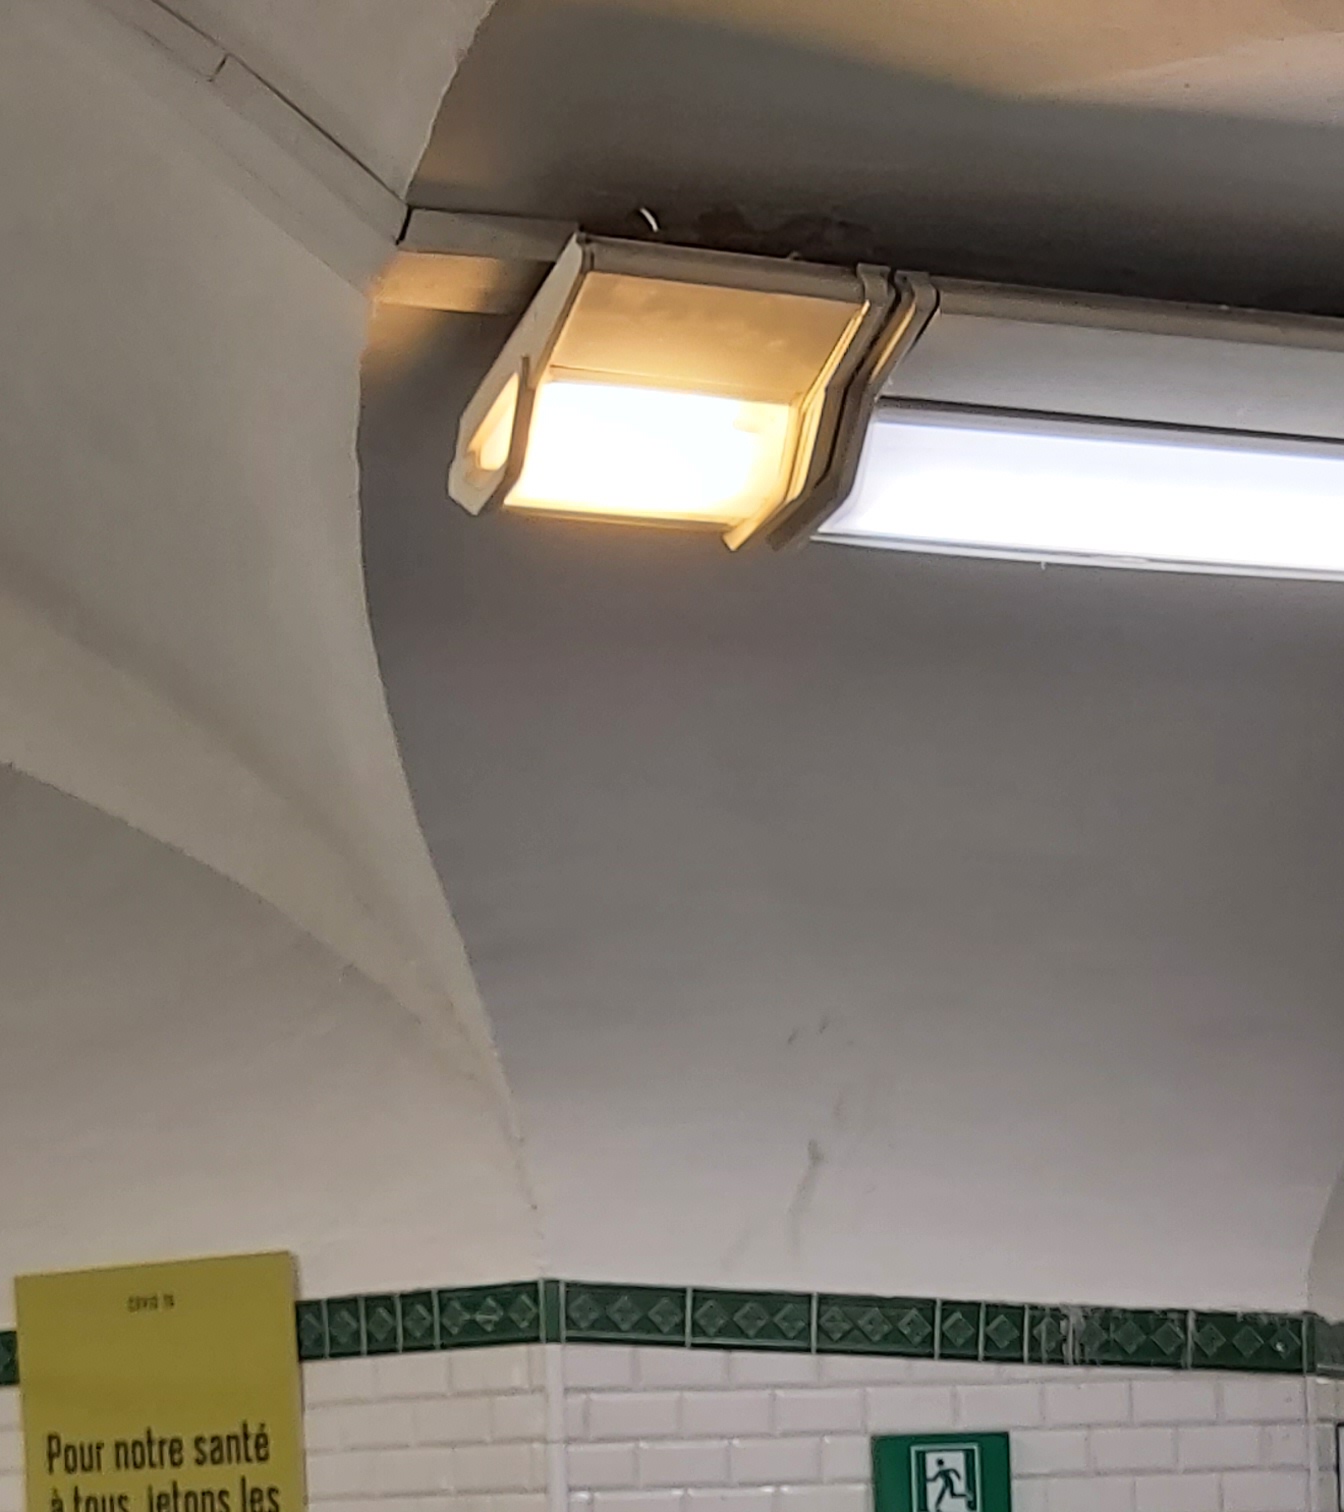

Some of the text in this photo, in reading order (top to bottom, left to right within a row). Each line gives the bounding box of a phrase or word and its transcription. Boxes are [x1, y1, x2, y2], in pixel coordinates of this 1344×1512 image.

[46, 1419, 270, 1475] Pour notre santé
